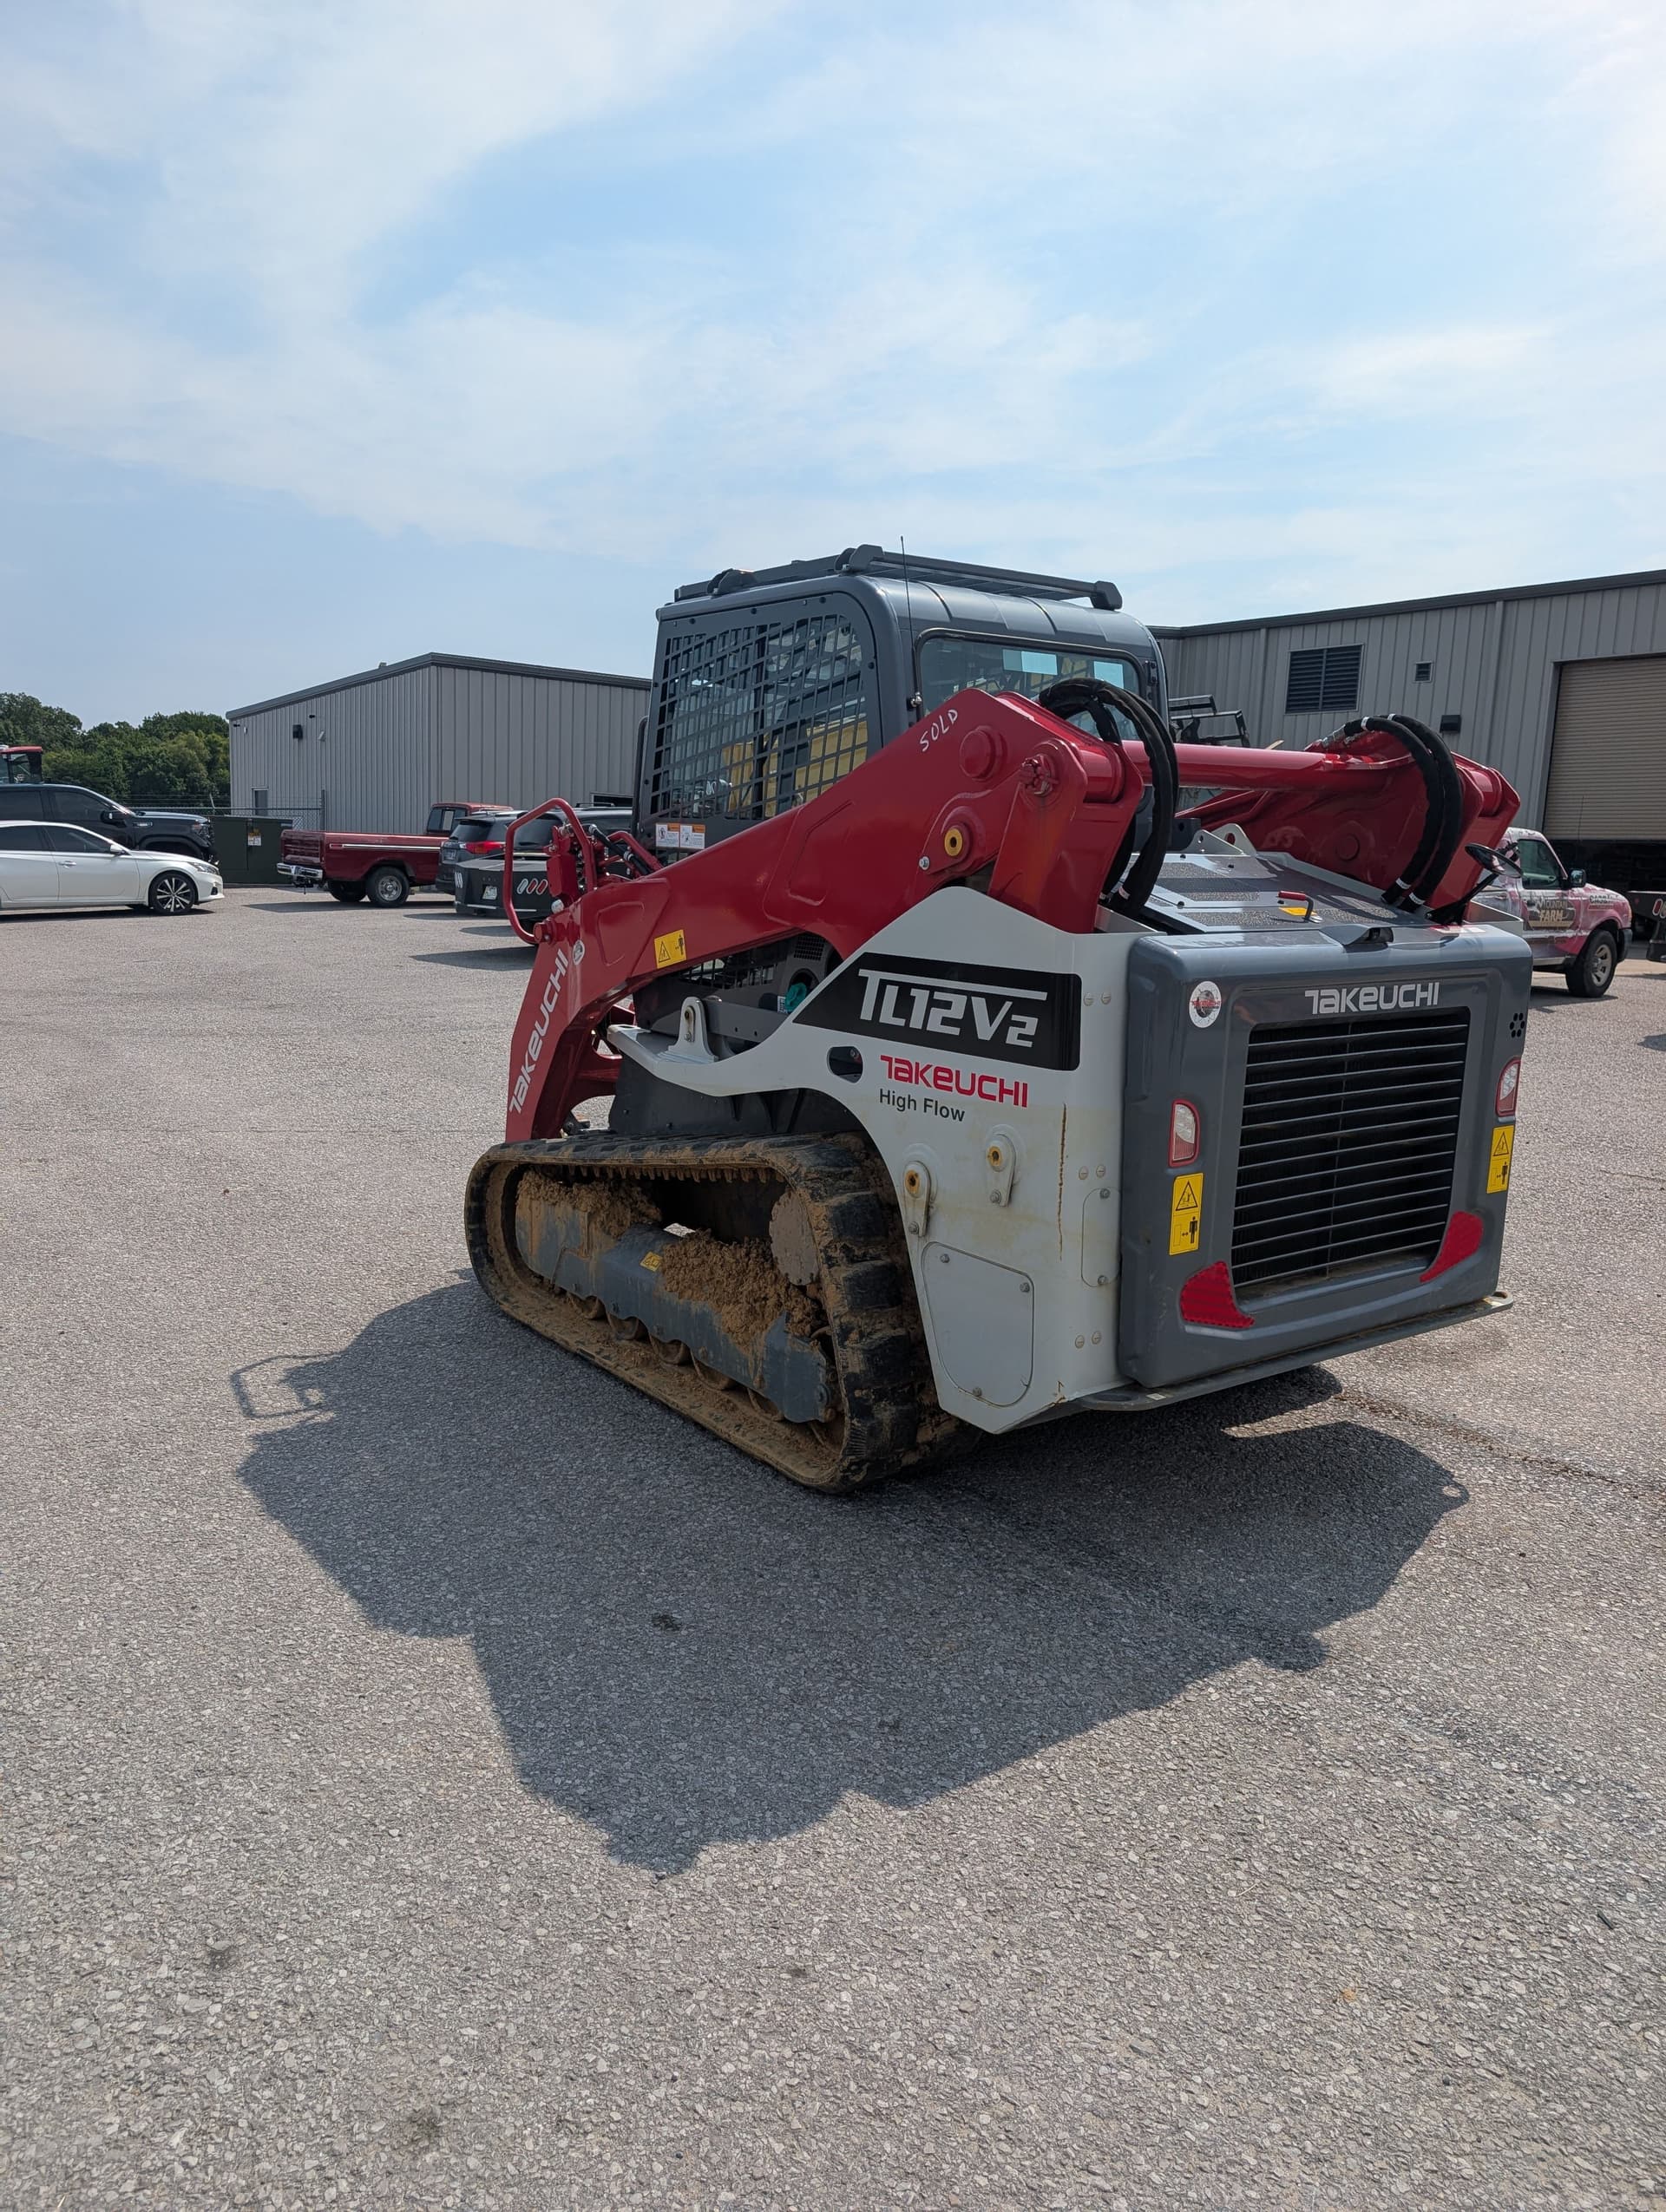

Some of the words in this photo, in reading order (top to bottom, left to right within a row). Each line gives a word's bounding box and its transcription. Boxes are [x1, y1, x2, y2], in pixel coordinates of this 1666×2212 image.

[920, 709, 958, 752] SOLD
[1539, 909, 1564, 922] FARM
[858, 969, 1048, 1048] TL12V2
[1304, 981, 1440, 1015] TAKEUCHI
[509, 948, 568, 1114] TAKEUCHI
[880, 1055, 1028, 1108] TAKEUCHI
[879, 1088, 917, 1112] High
[923, 1097, 966, 1122] Flow
